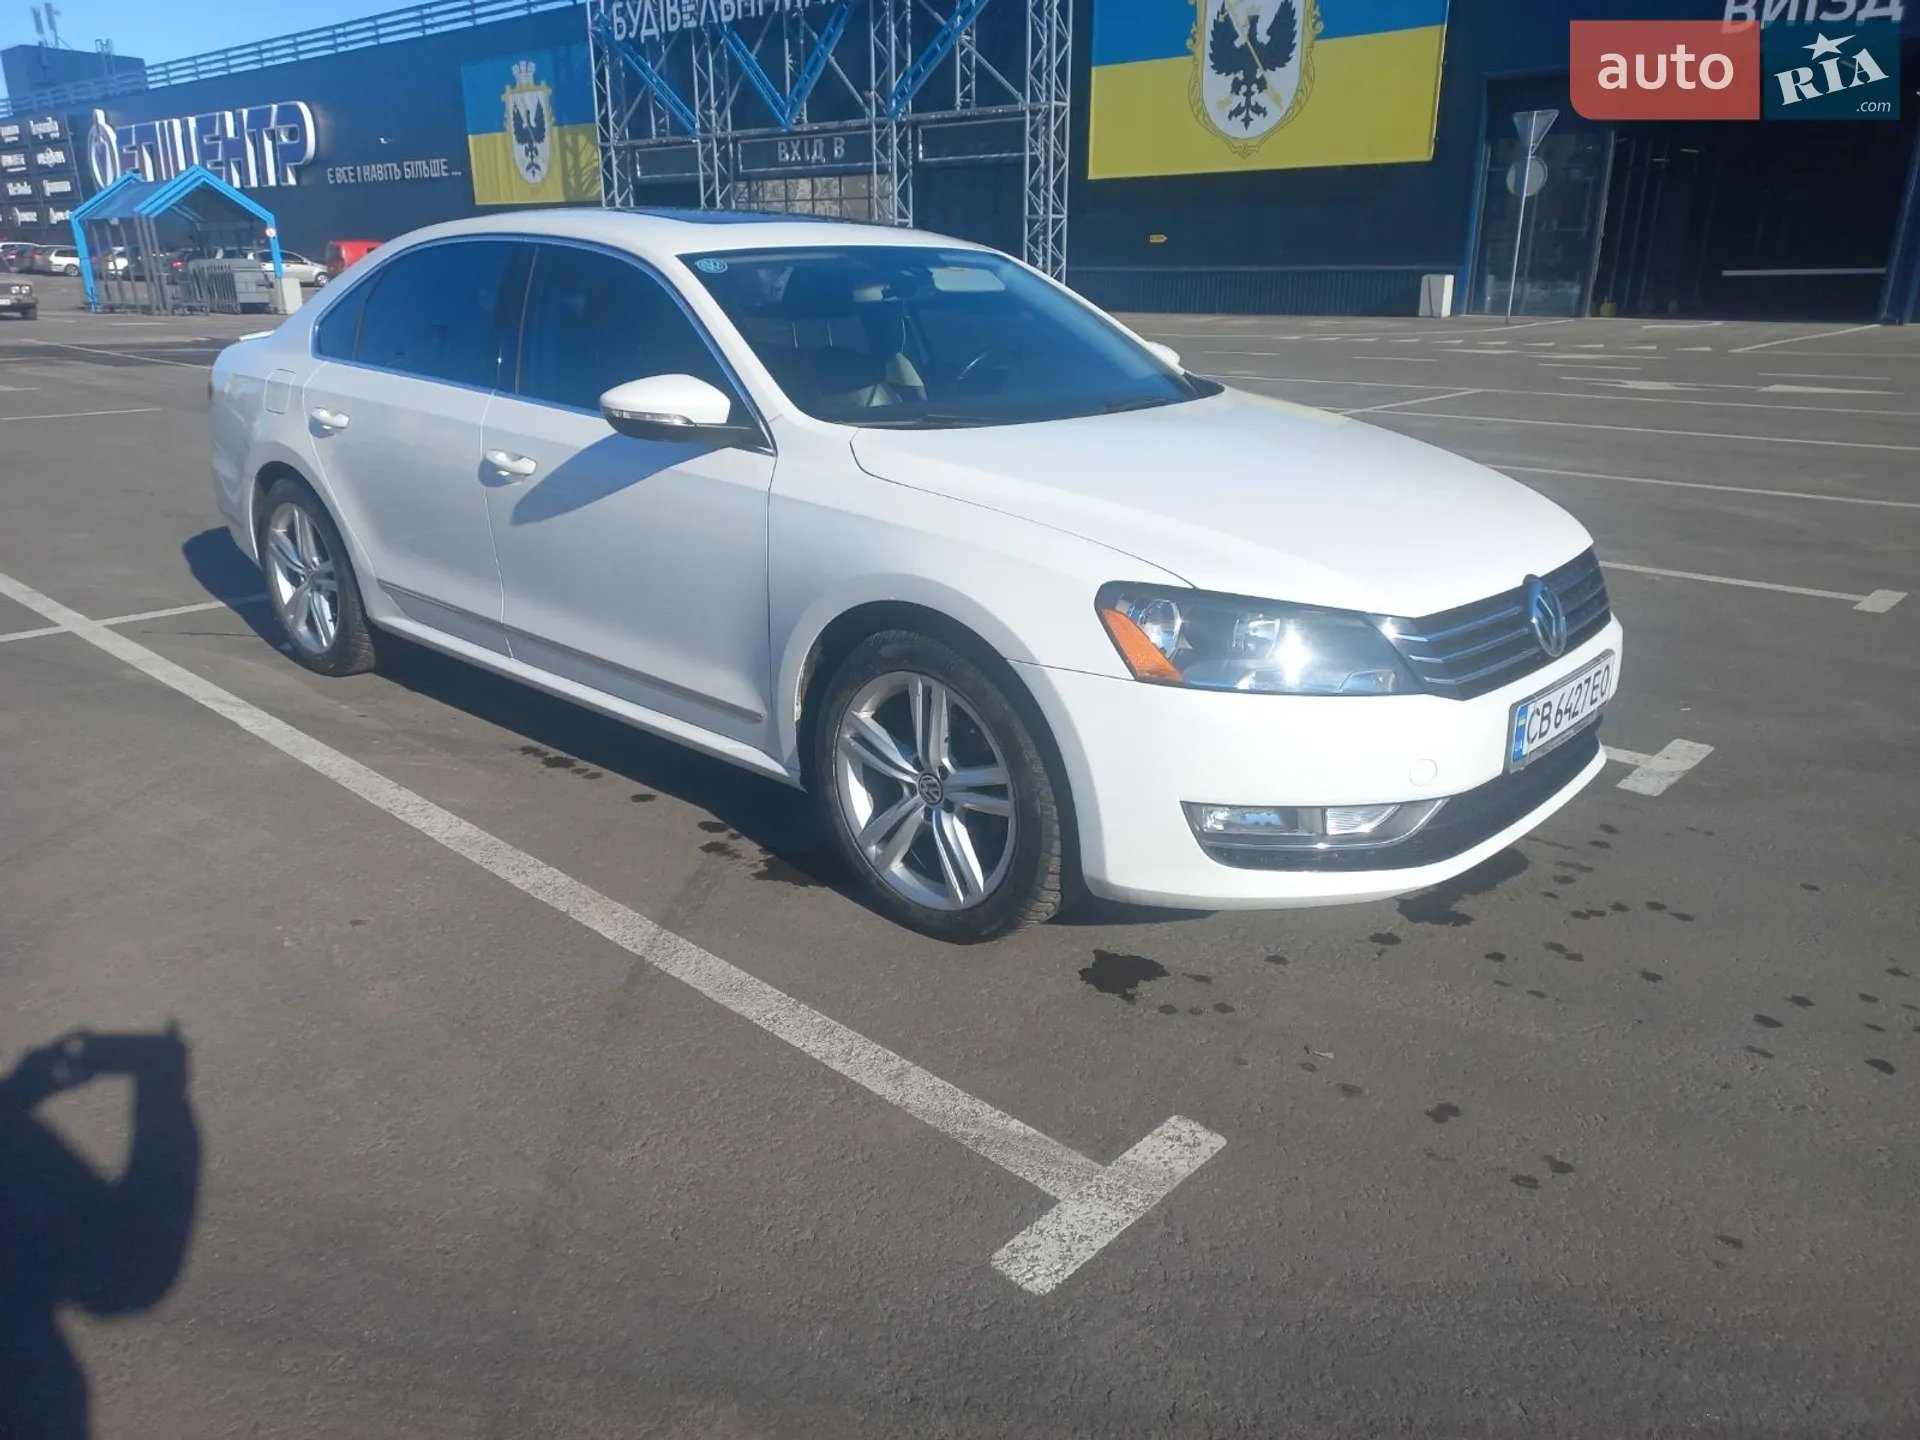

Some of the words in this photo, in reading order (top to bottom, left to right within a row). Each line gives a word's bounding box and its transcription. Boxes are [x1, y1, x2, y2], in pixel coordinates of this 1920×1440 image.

[778, 138, 826, 163] ВХІД
[833, 136, 846, 159] В
[337, 167, 356, 183] ВСЕ
[363, 162, 401, 181] НАВІТЬ
